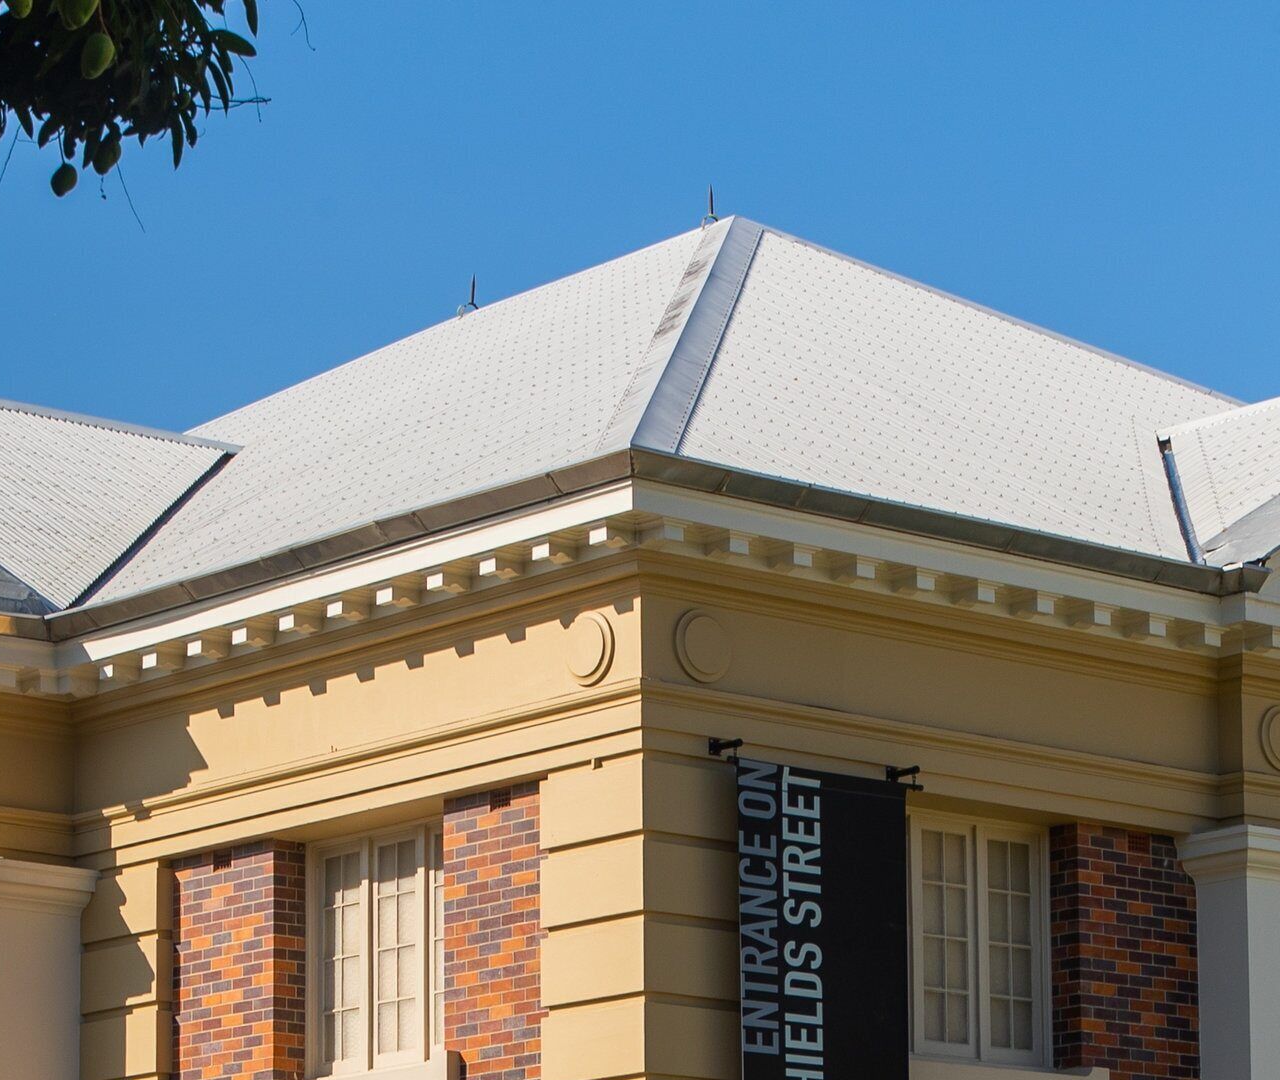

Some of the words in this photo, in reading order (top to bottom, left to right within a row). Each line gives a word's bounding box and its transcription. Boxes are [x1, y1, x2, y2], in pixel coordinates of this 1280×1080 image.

[737, 758, 778, 822] ON
[782, 766, 823, 928] STREET
[738, 830, 780, 1055] ENTRANCE
